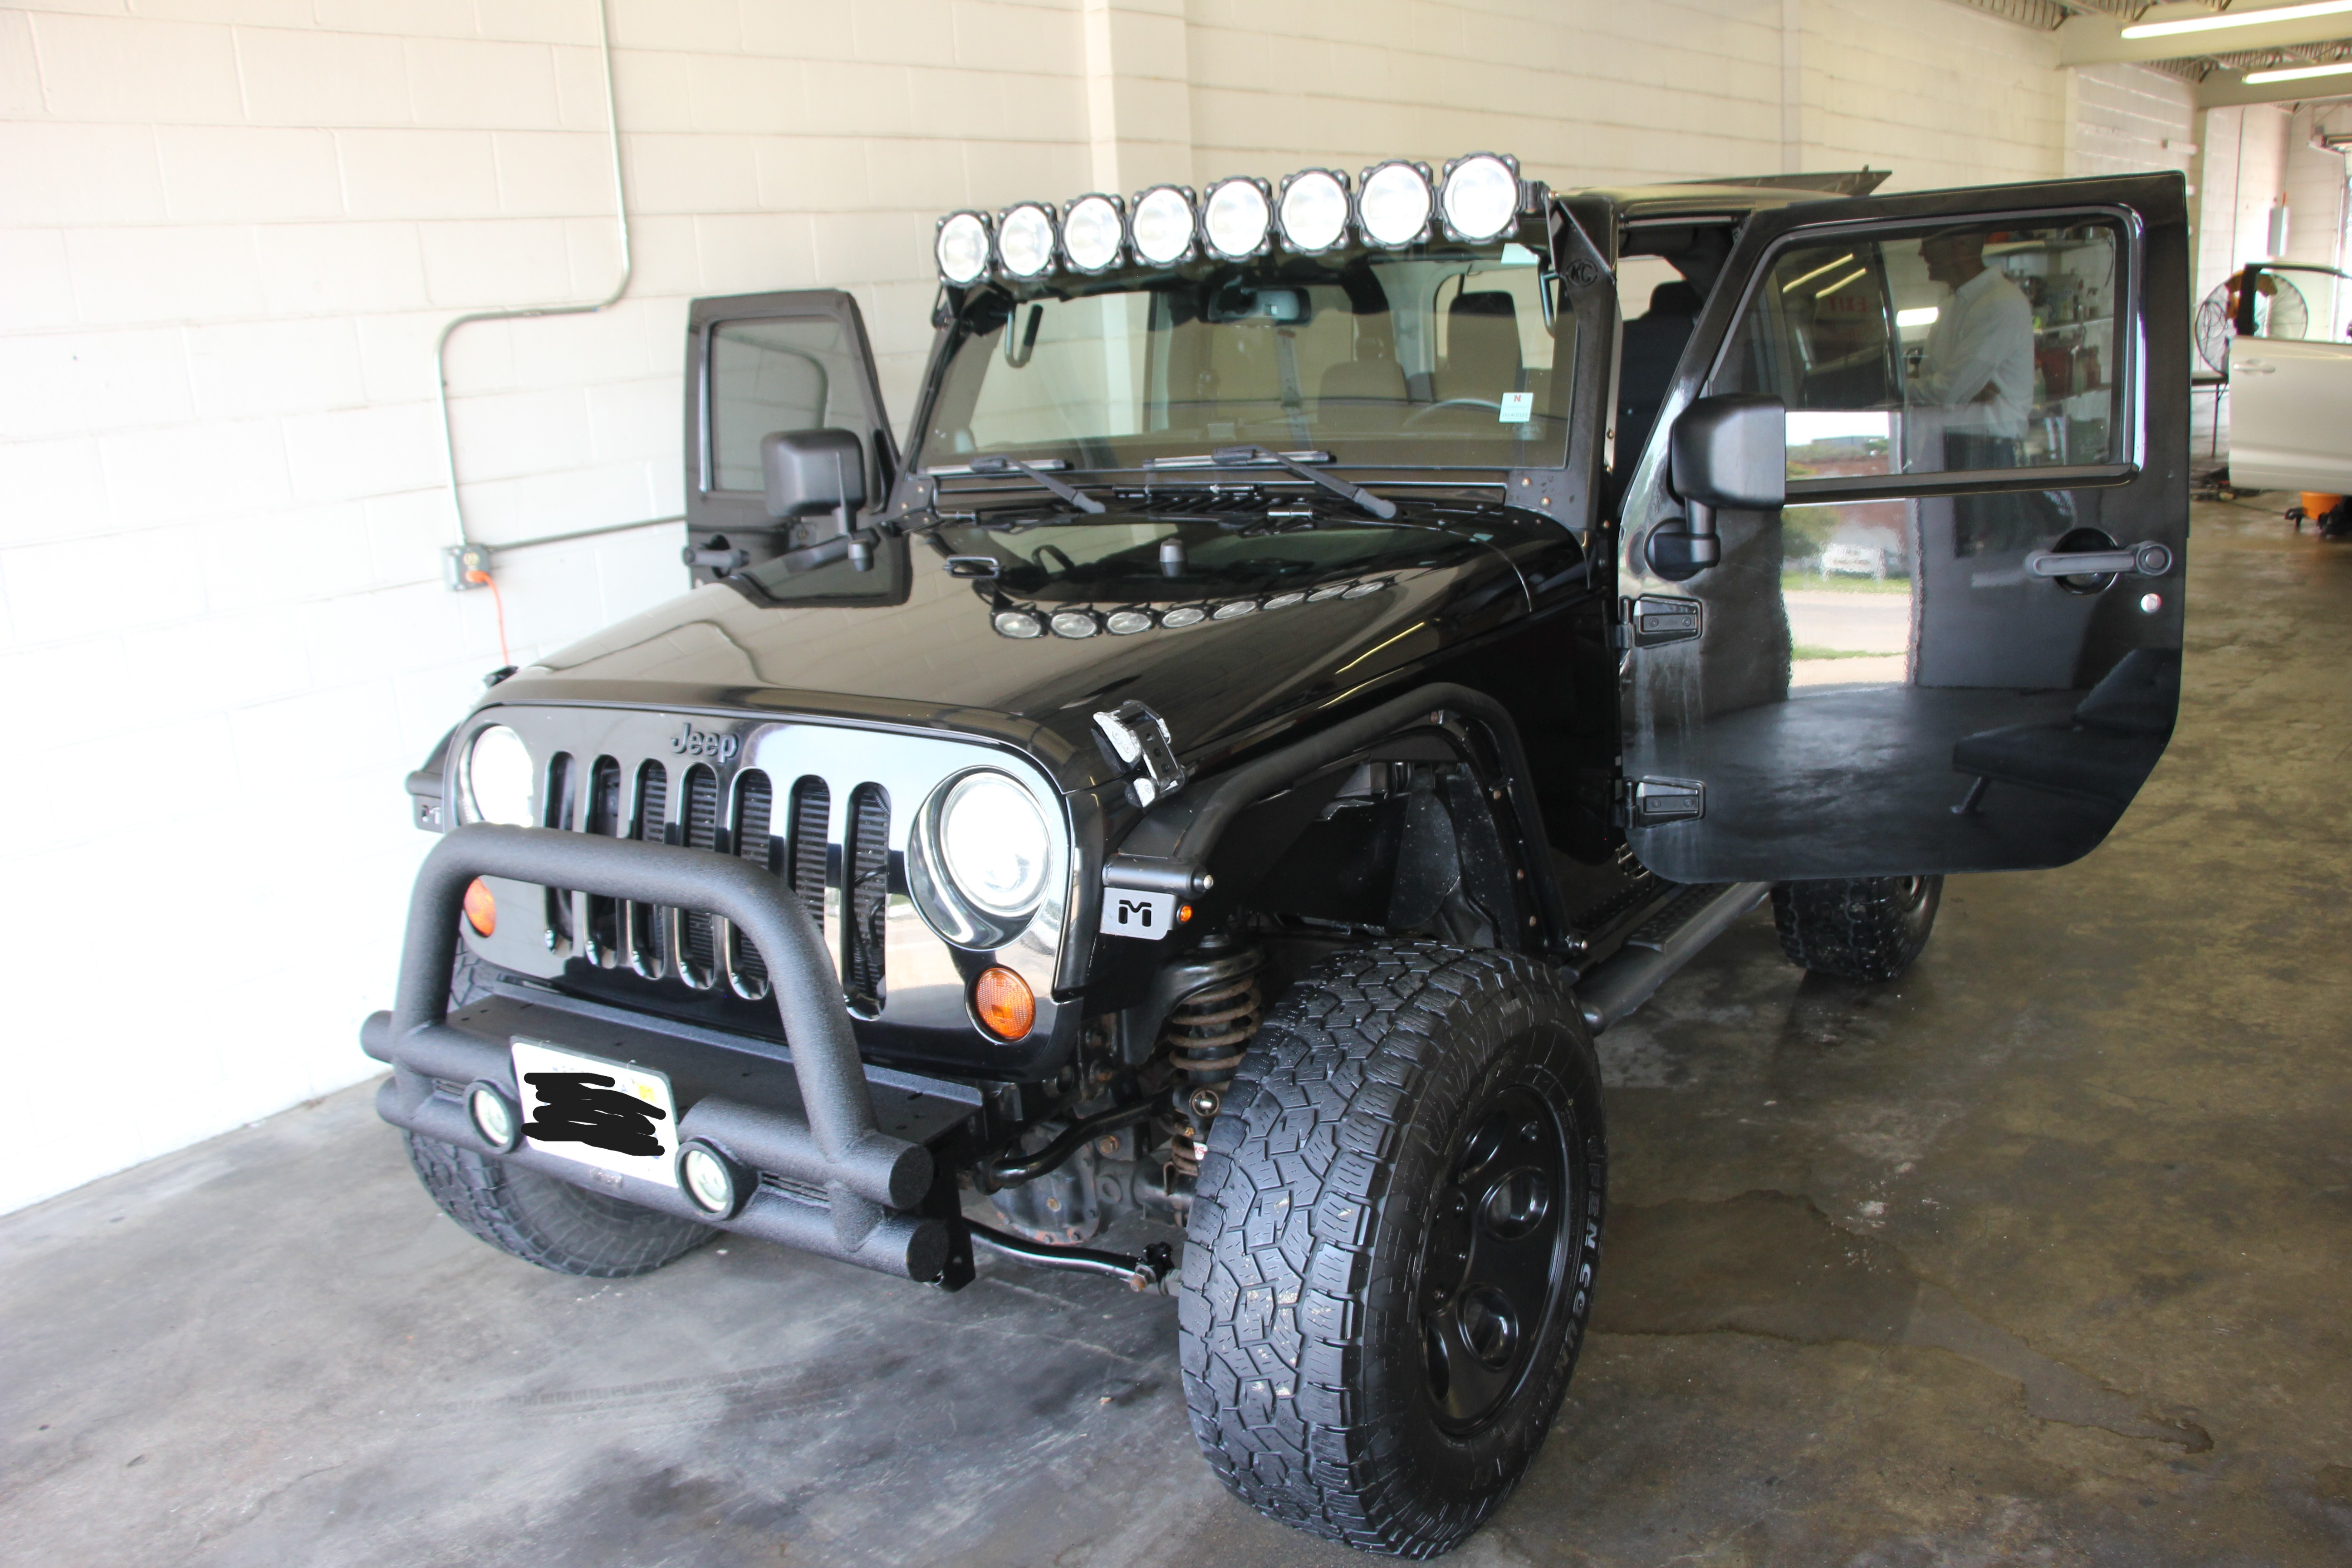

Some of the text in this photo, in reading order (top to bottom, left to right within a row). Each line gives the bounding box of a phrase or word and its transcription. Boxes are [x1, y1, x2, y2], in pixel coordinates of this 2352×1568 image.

[1570, 262, 1593, 283] KC
[670, 722, 739, 763] Jeep
[1118, 899, 1152, 927] M
